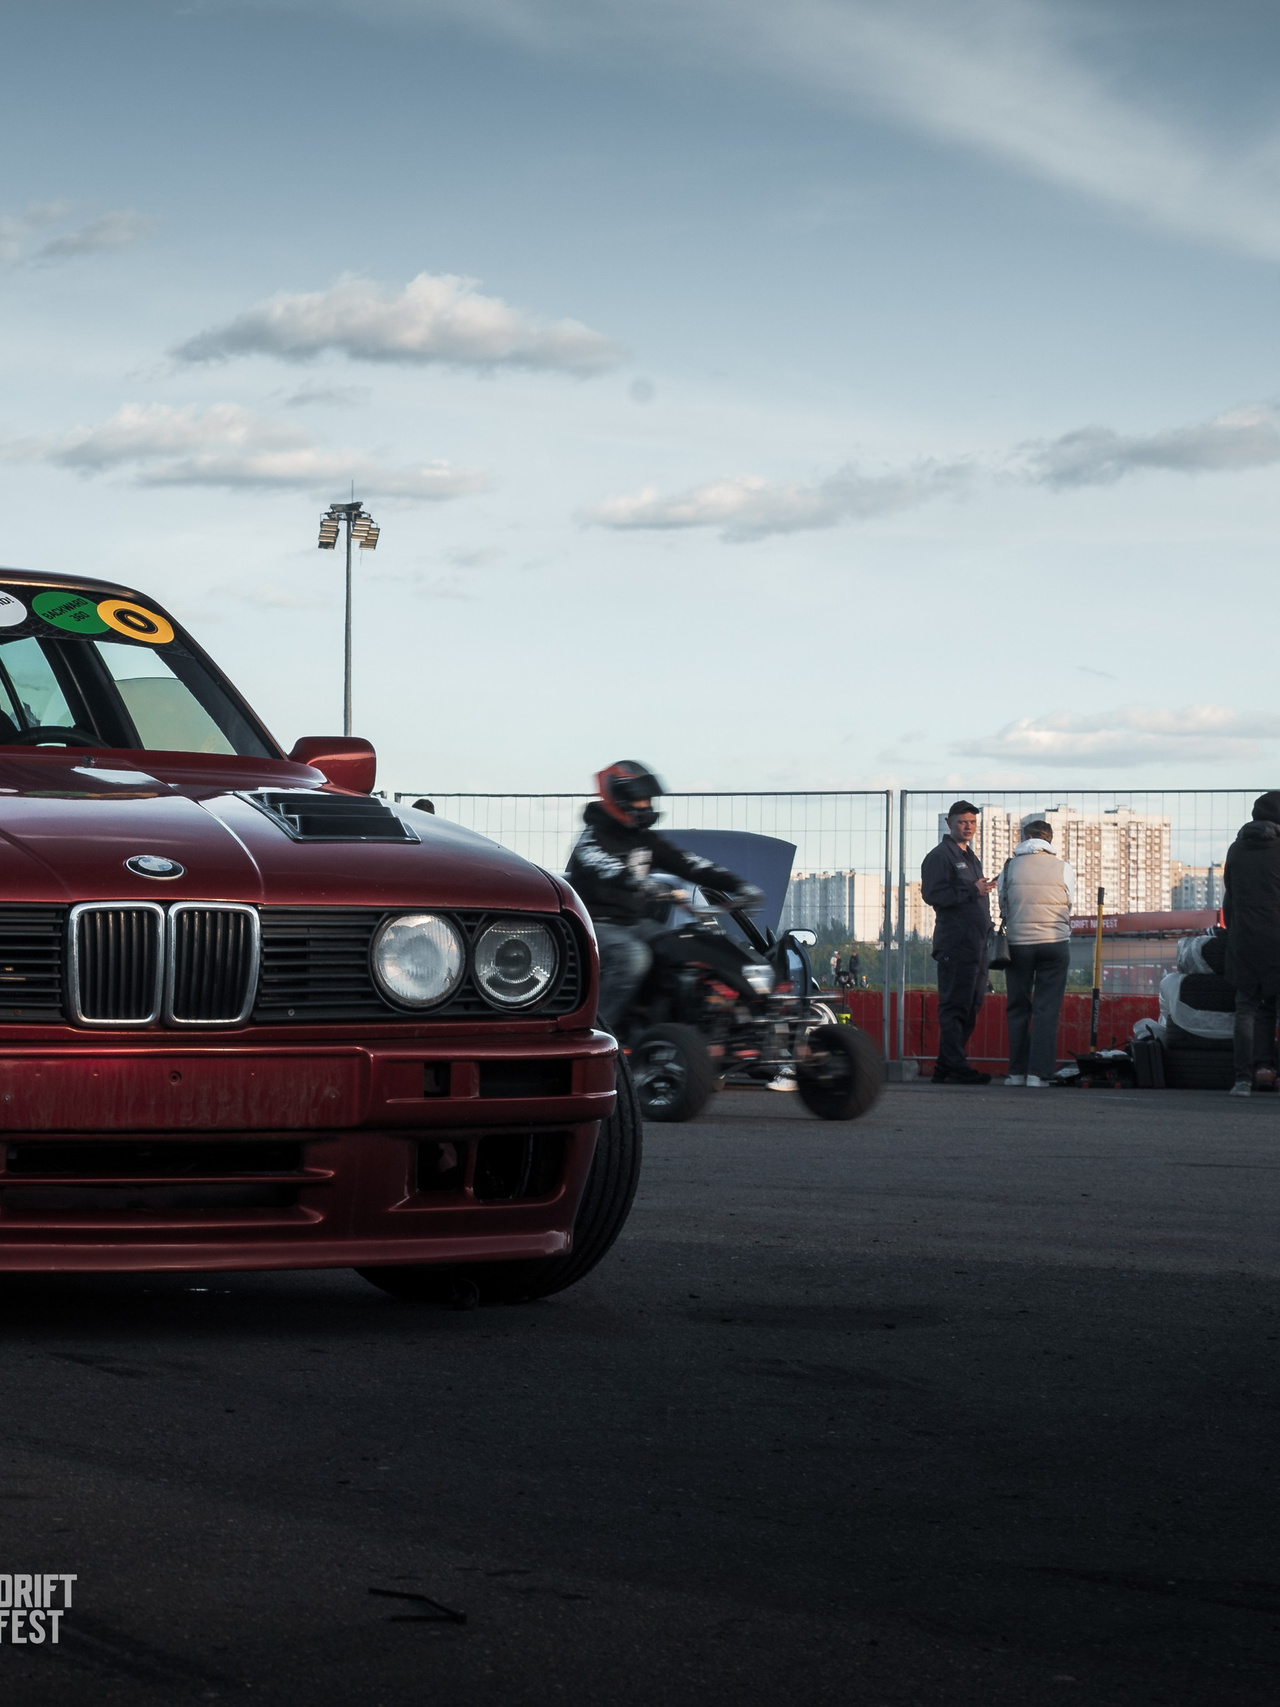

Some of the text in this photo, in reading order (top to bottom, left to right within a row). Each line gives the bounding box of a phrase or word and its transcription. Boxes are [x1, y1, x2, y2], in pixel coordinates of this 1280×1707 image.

[41, 597, 89, 620] BACKWARD
[1070, 920, 1089, 929] DRIFT
[1103, 919, 1118, 928] FEST
